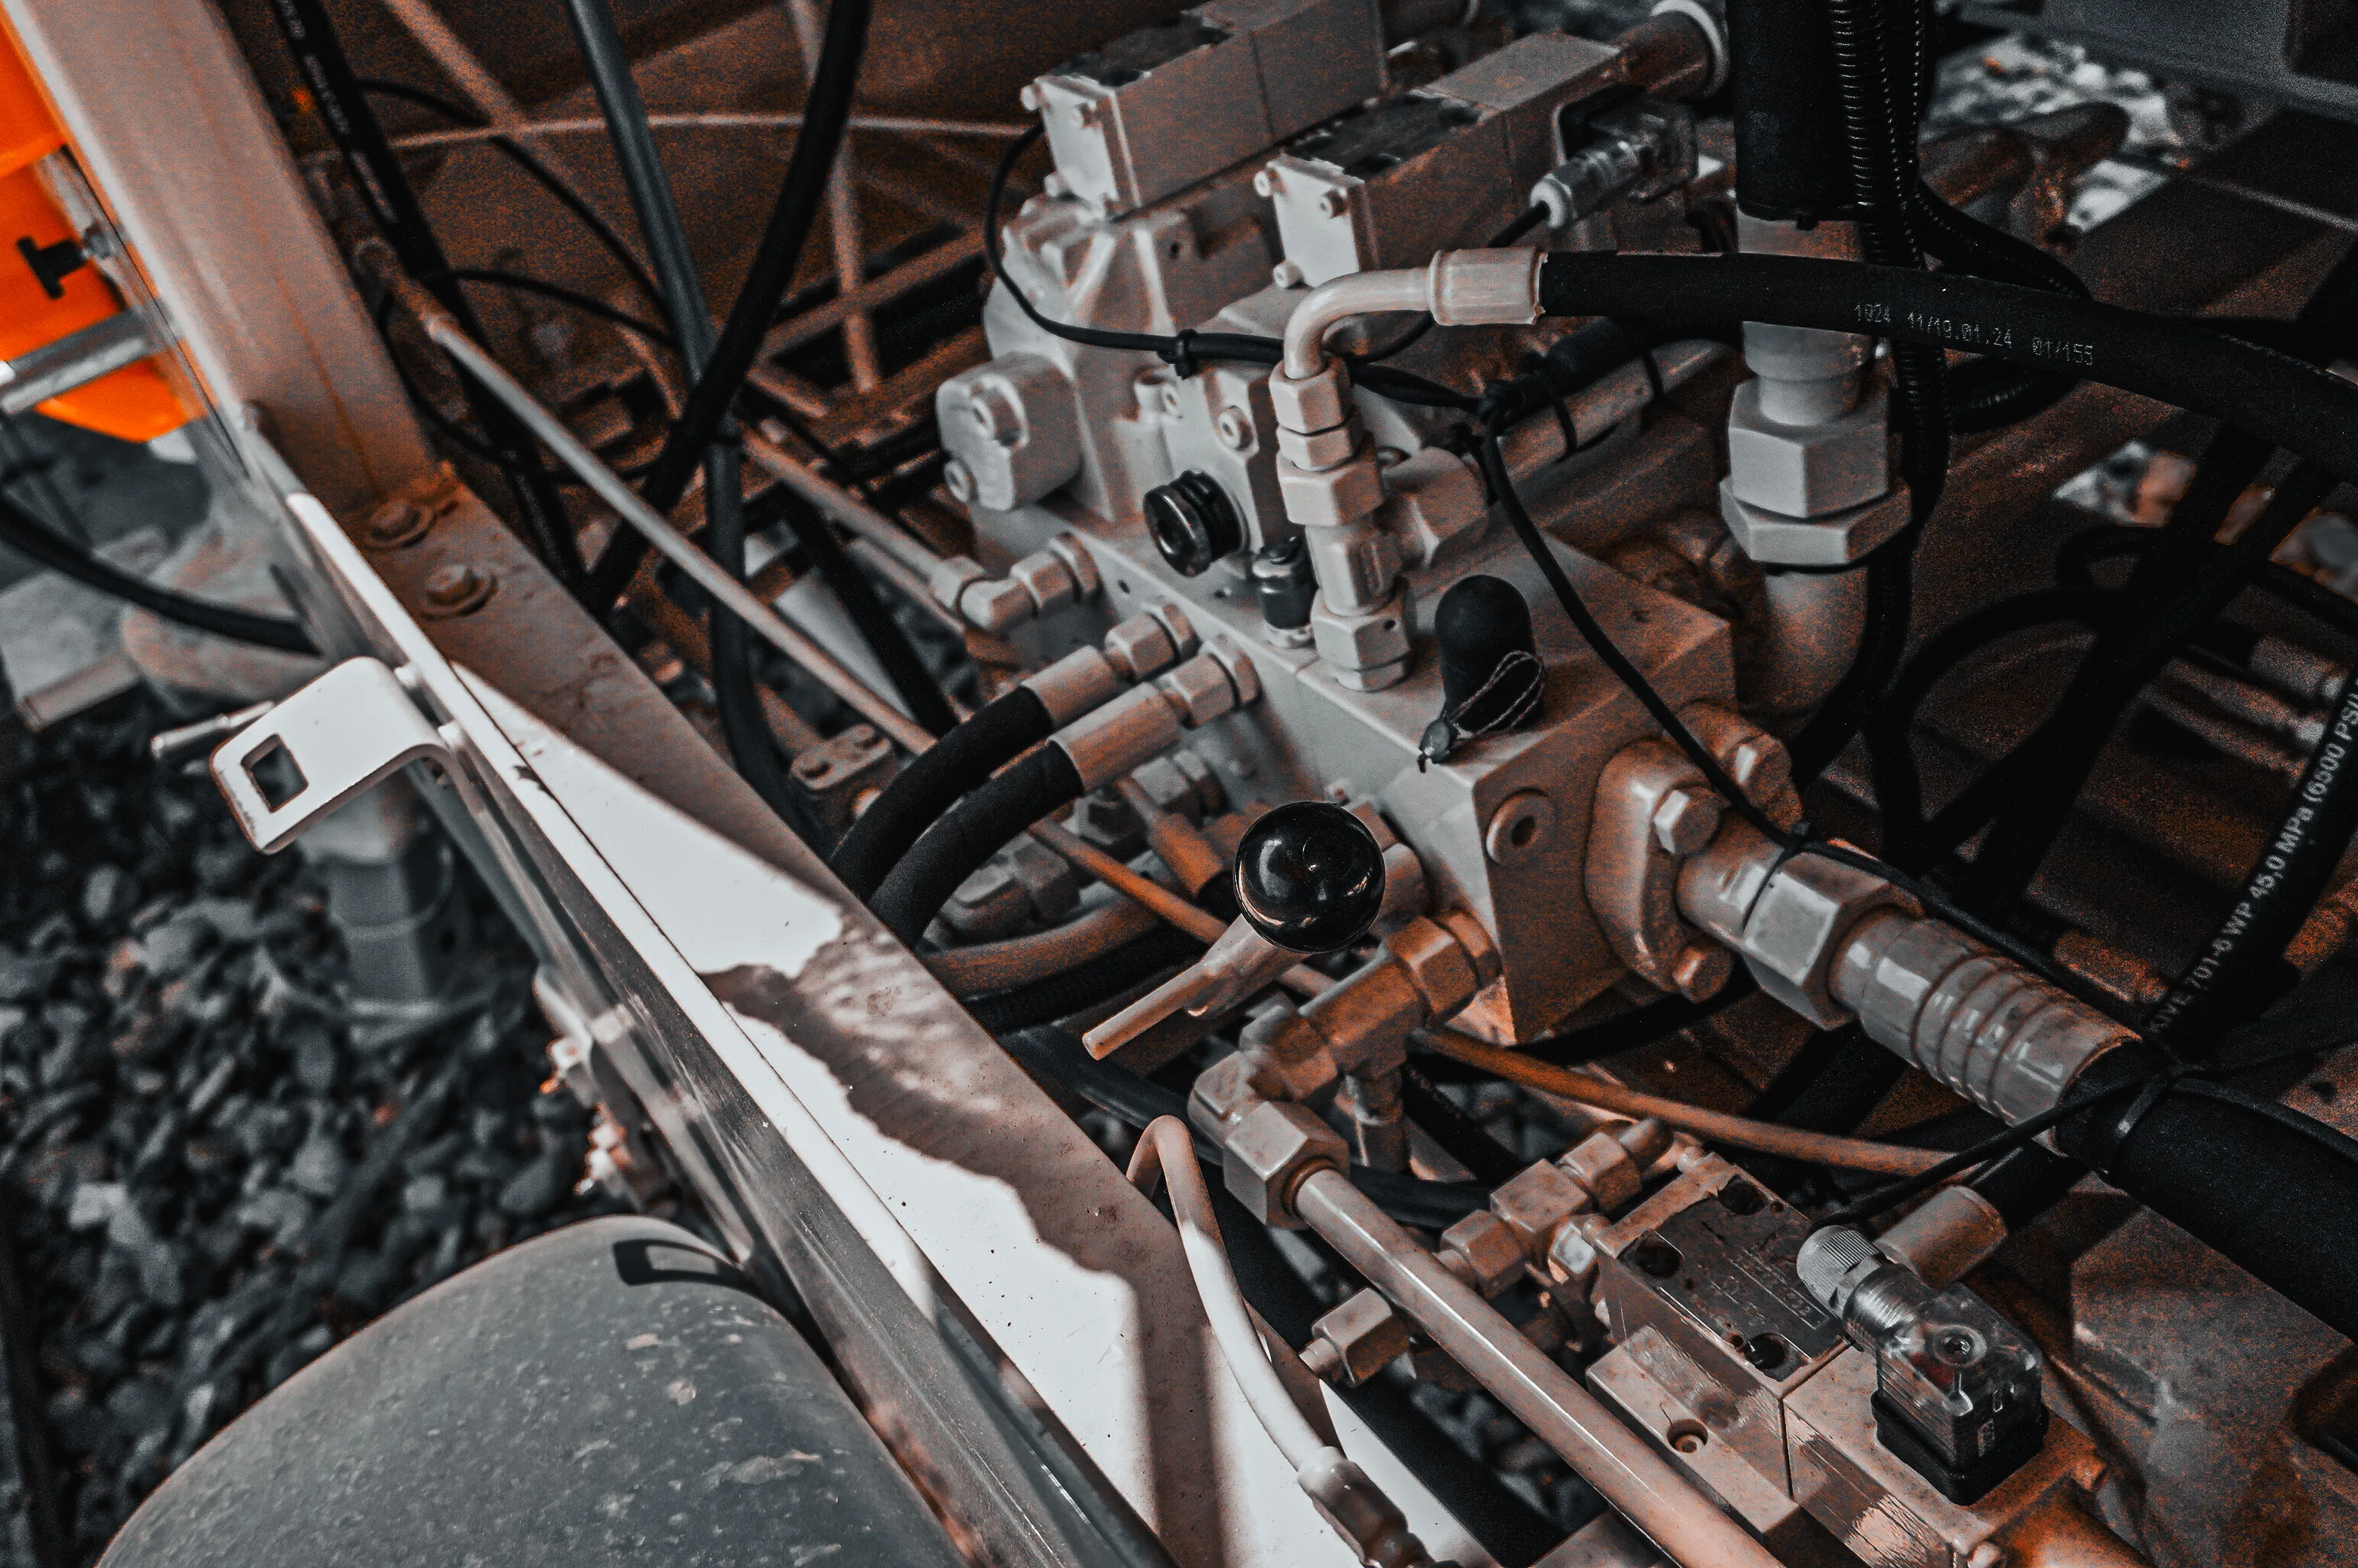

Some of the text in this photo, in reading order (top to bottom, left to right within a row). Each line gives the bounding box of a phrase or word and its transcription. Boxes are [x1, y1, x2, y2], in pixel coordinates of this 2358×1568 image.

[2220, 901, 2254, 935] WP
[2249, 853, 2287, 899] 45,0
[2274, 806, 2315, 854] MPa
